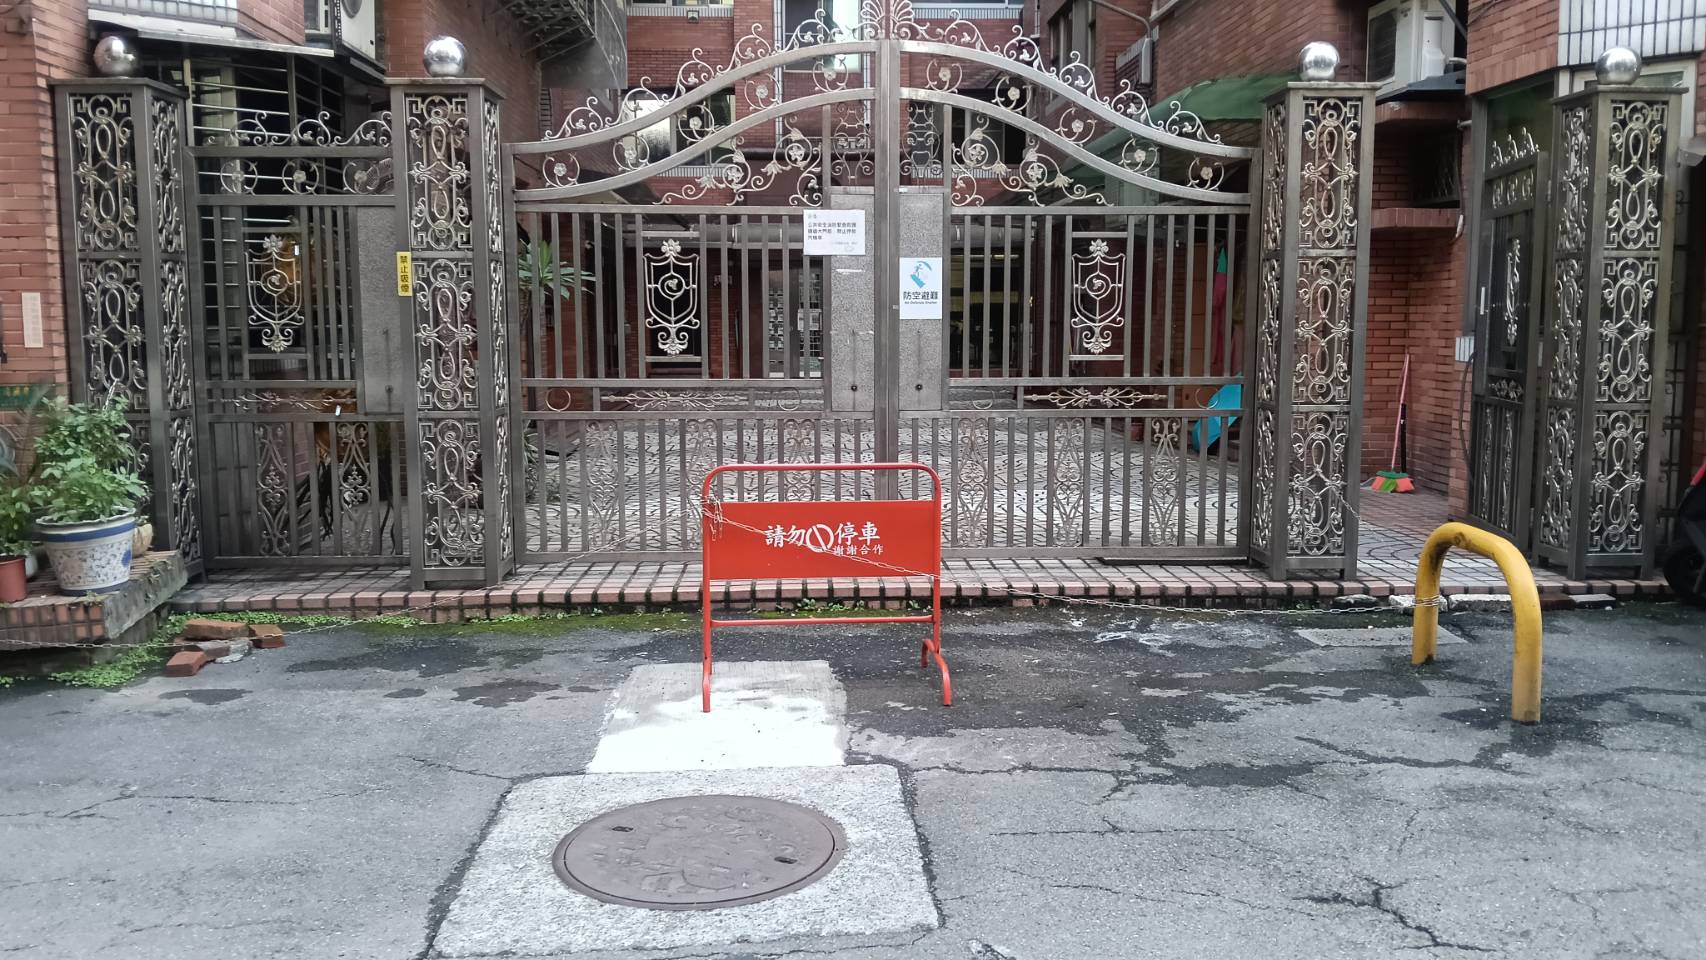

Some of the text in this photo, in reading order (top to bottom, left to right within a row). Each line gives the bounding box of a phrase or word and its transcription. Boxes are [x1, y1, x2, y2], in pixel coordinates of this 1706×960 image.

[903, 291, 938, 300] 防空避難
[765, 521, 880, 548] 請勿 停車
[833, 545, 884, 556] 謝謝合作
